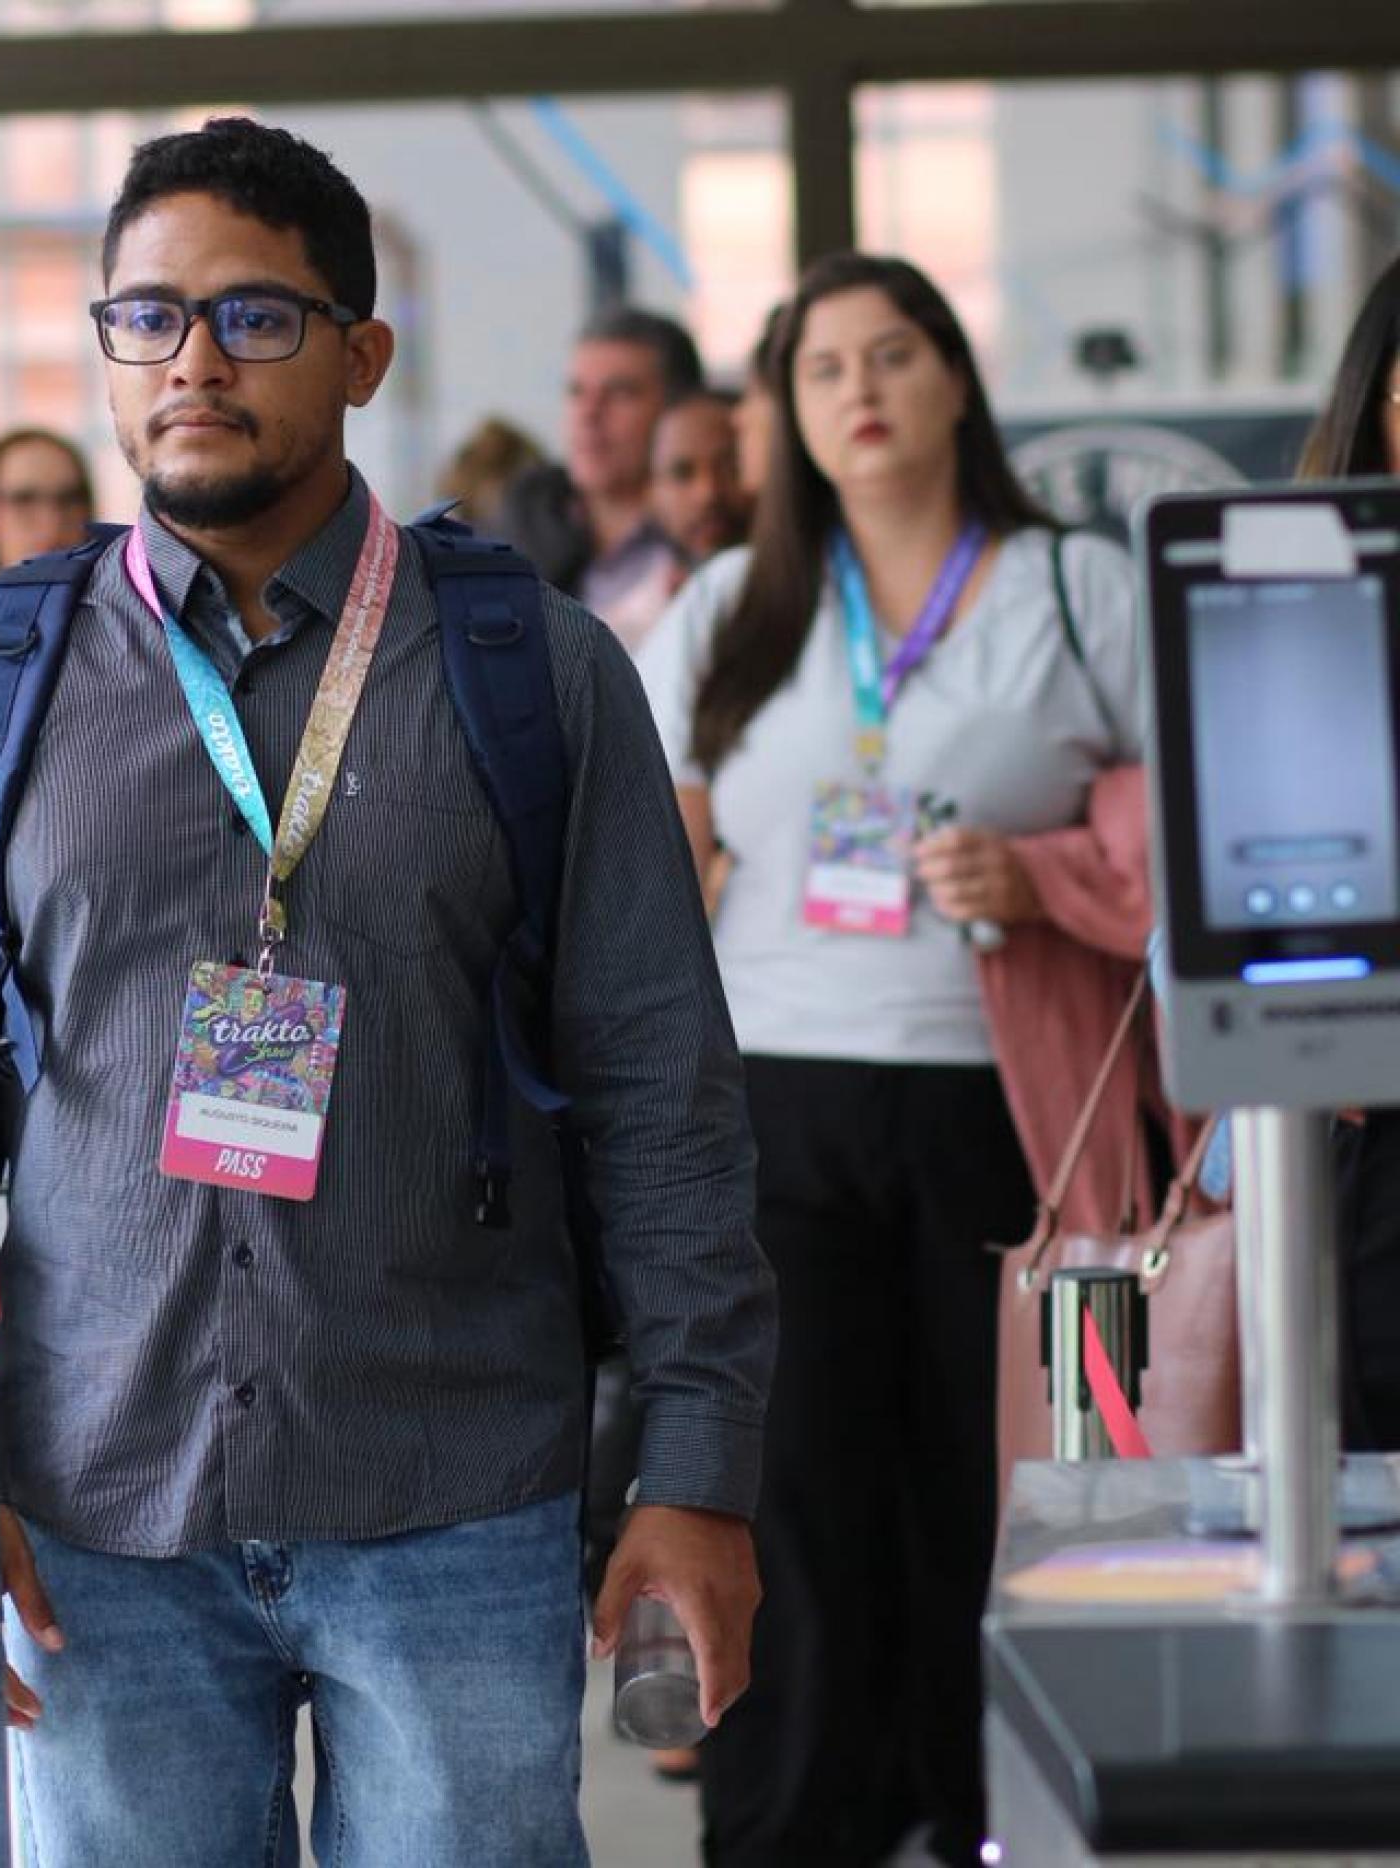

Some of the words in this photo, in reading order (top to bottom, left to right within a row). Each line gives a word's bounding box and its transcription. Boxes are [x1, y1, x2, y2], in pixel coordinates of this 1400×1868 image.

[208, 713, 250, 799] trakto
[214, 1019, 311, 1043] trakto
[214, 1148, 267, 1179] PASS
